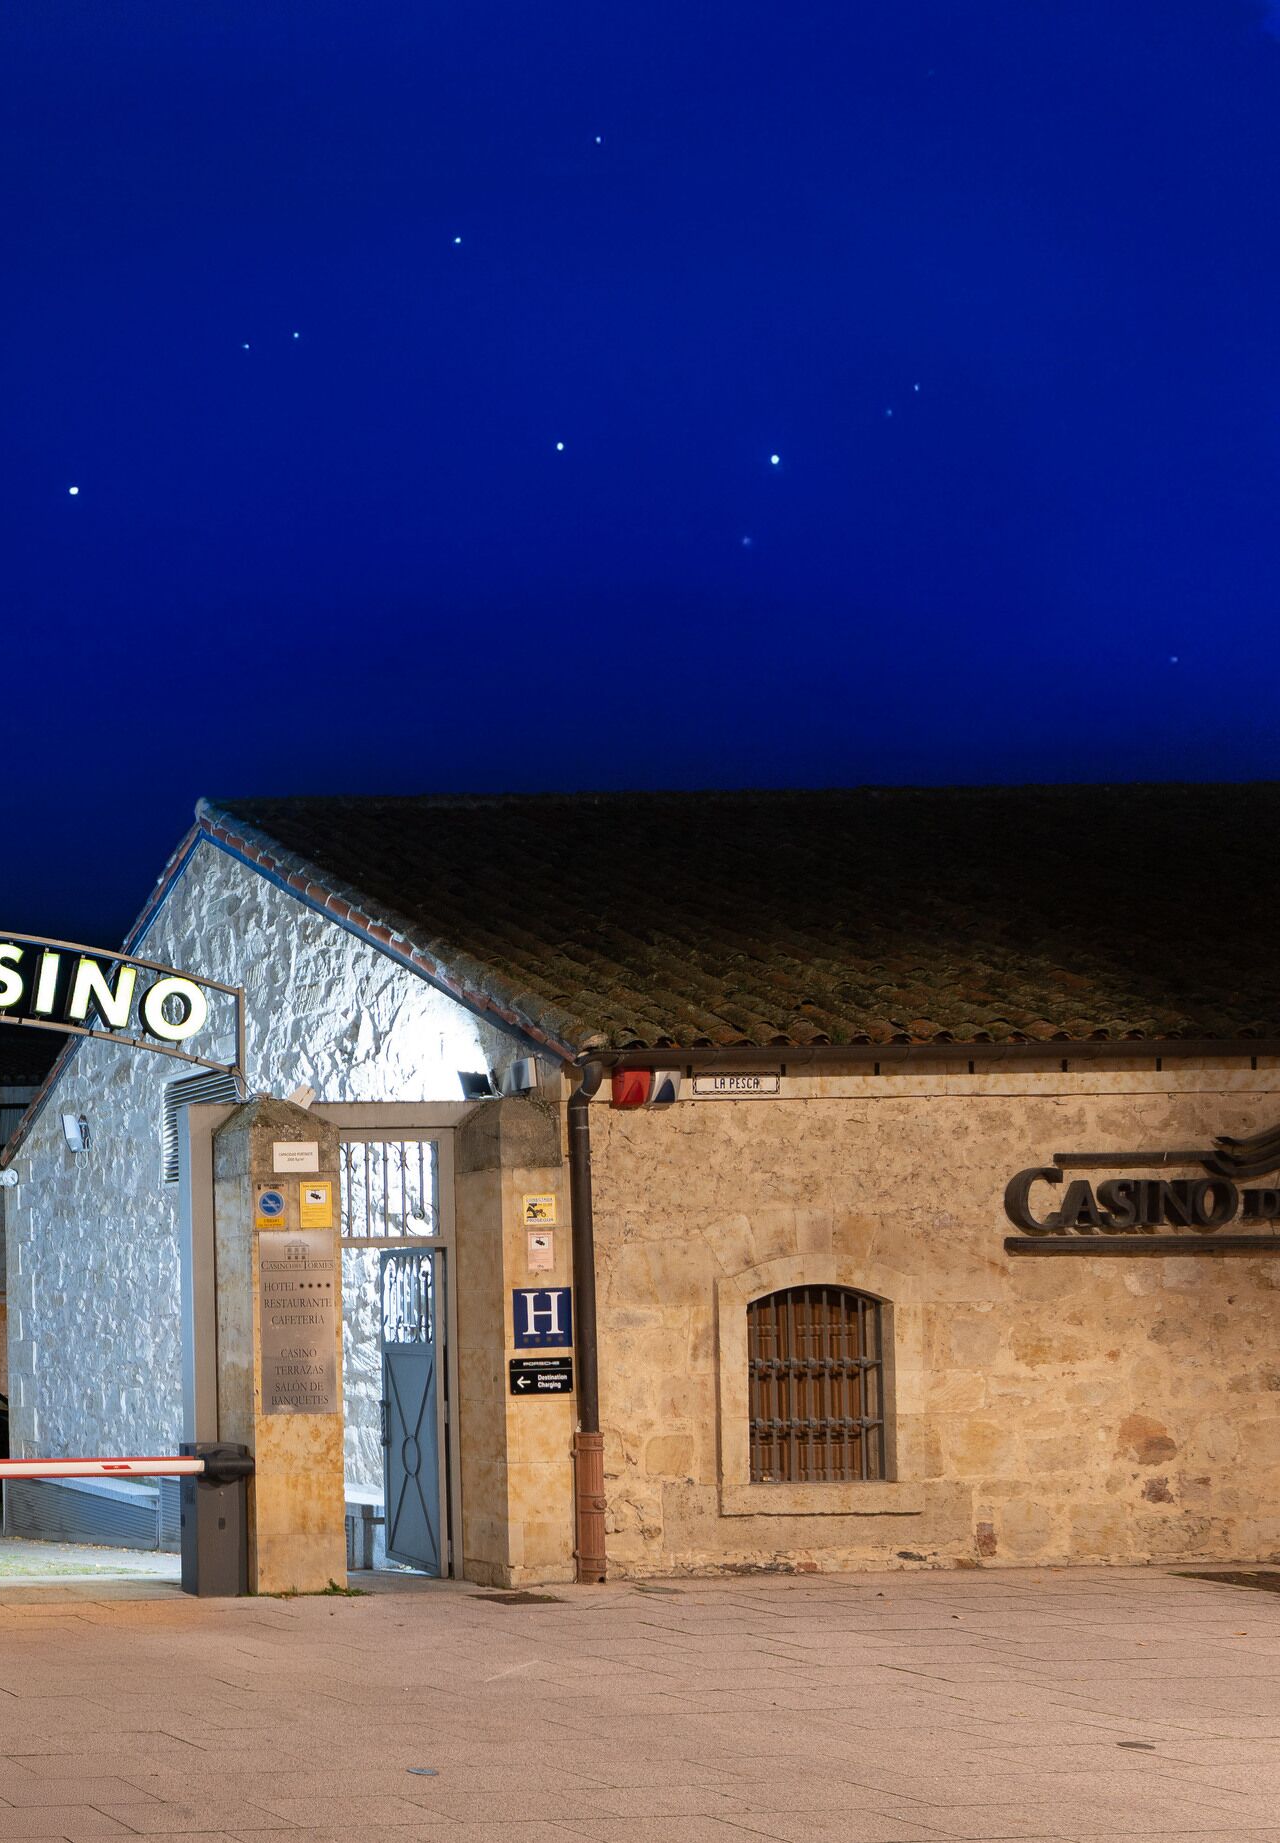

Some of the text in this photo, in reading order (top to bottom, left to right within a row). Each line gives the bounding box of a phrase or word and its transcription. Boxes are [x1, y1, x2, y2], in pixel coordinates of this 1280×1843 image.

[714, 1077, 759, 1089] LA PESCA
[1004, 1167, 1239, 1236] CASINO
[261, 1260, 291, 1270] CASINO
[302, 1260, 334, 1270] TORMES
[264, 1282, 297, 1292] HOTEL
[264, 1298, 332, 1308] RESTAURANTE
[521, 1291, 564, 1335] H
[281, 1348, 317, 1358] CASINO
[275, 1365, 324, 1375] TERRAZAS
[275, 1380, 324, 1392] SALÓN DE
[537, 1381, 562, 1389] Charging
[271, 1395, 329, 1408] BANQUETES
